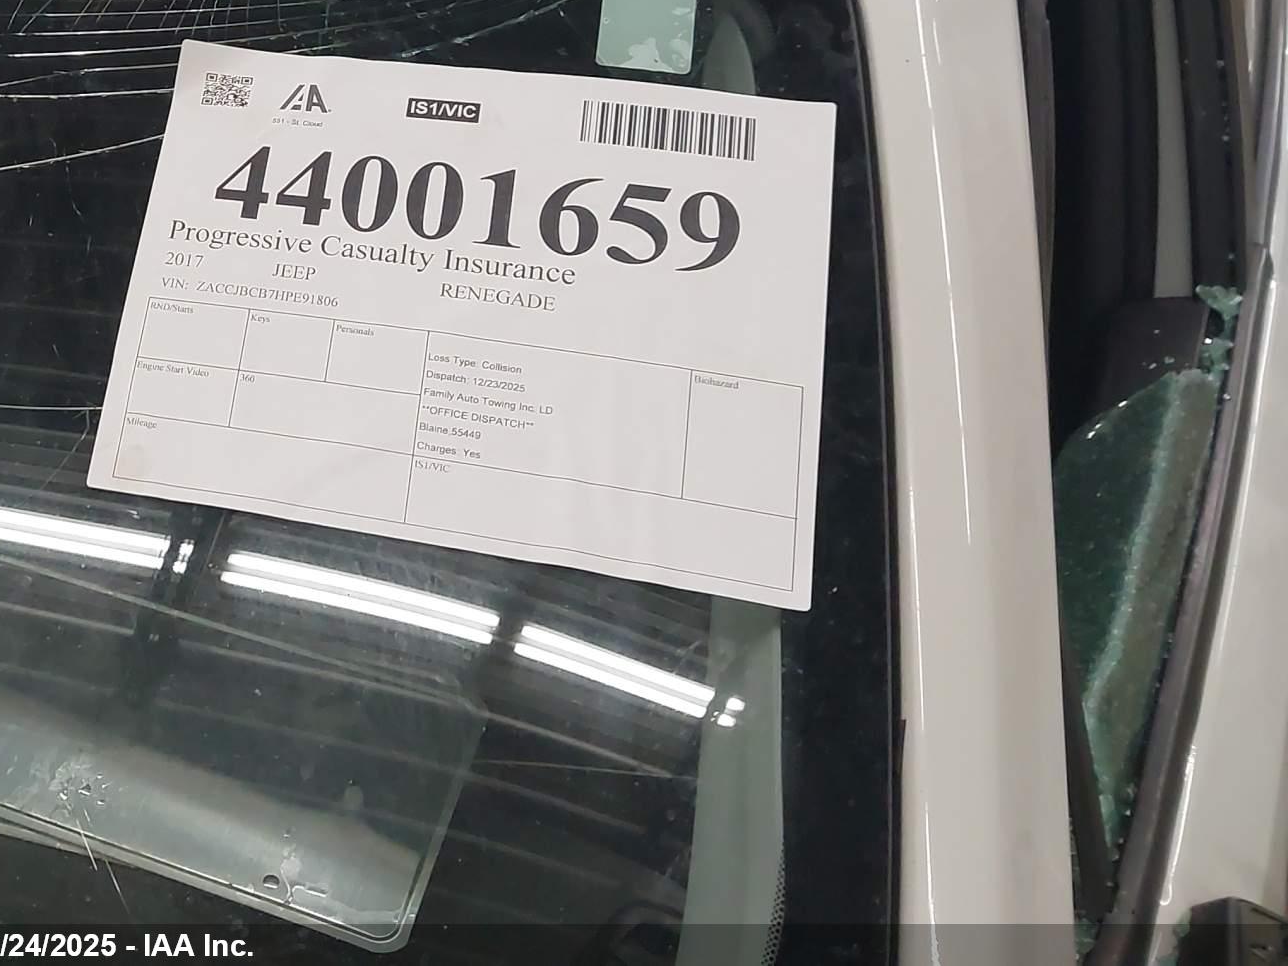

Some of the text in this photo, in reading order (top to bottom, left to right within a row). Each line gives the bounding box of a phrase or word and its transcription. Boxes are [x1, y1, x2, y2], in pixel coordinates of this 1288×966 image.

[409, 100, 477, 119] IS1/VIC
[302, 120, 323, 128] Cloud
[214, 145, 741, 272] 44001659
[169, 219, 576, 285] Progressive Casualty Insurance
[165, 252, 556, 312] 2017 JEEP RENEGADE
[161, 277, 339, 308] VIN: ZACCJBCB7HPE91806
[150, 301, 194, 314] RND/Starts
[250, 314, 270, 324] Keys
[336, 324, 375, 337] Personals
[137, 361, 209, 377] Engine Start Video
[428, 353, 450, 366] Loss
[482, 360, 522, 374] Collision
[240, 374, 255, 383] 360
[426, 370, 525, 393] Dispatch: 12/23/2025
[695, 375, 739, 390] Biohazard
[424, 388, 455, 401] Family
[457, 392, 479, 404] Auto
[482, 395, 516, 411] Towing
[540, 405, 553, 415] LD
[127, 417, 157, 429] Mileage
[463, 449, 481, 459] Yes
